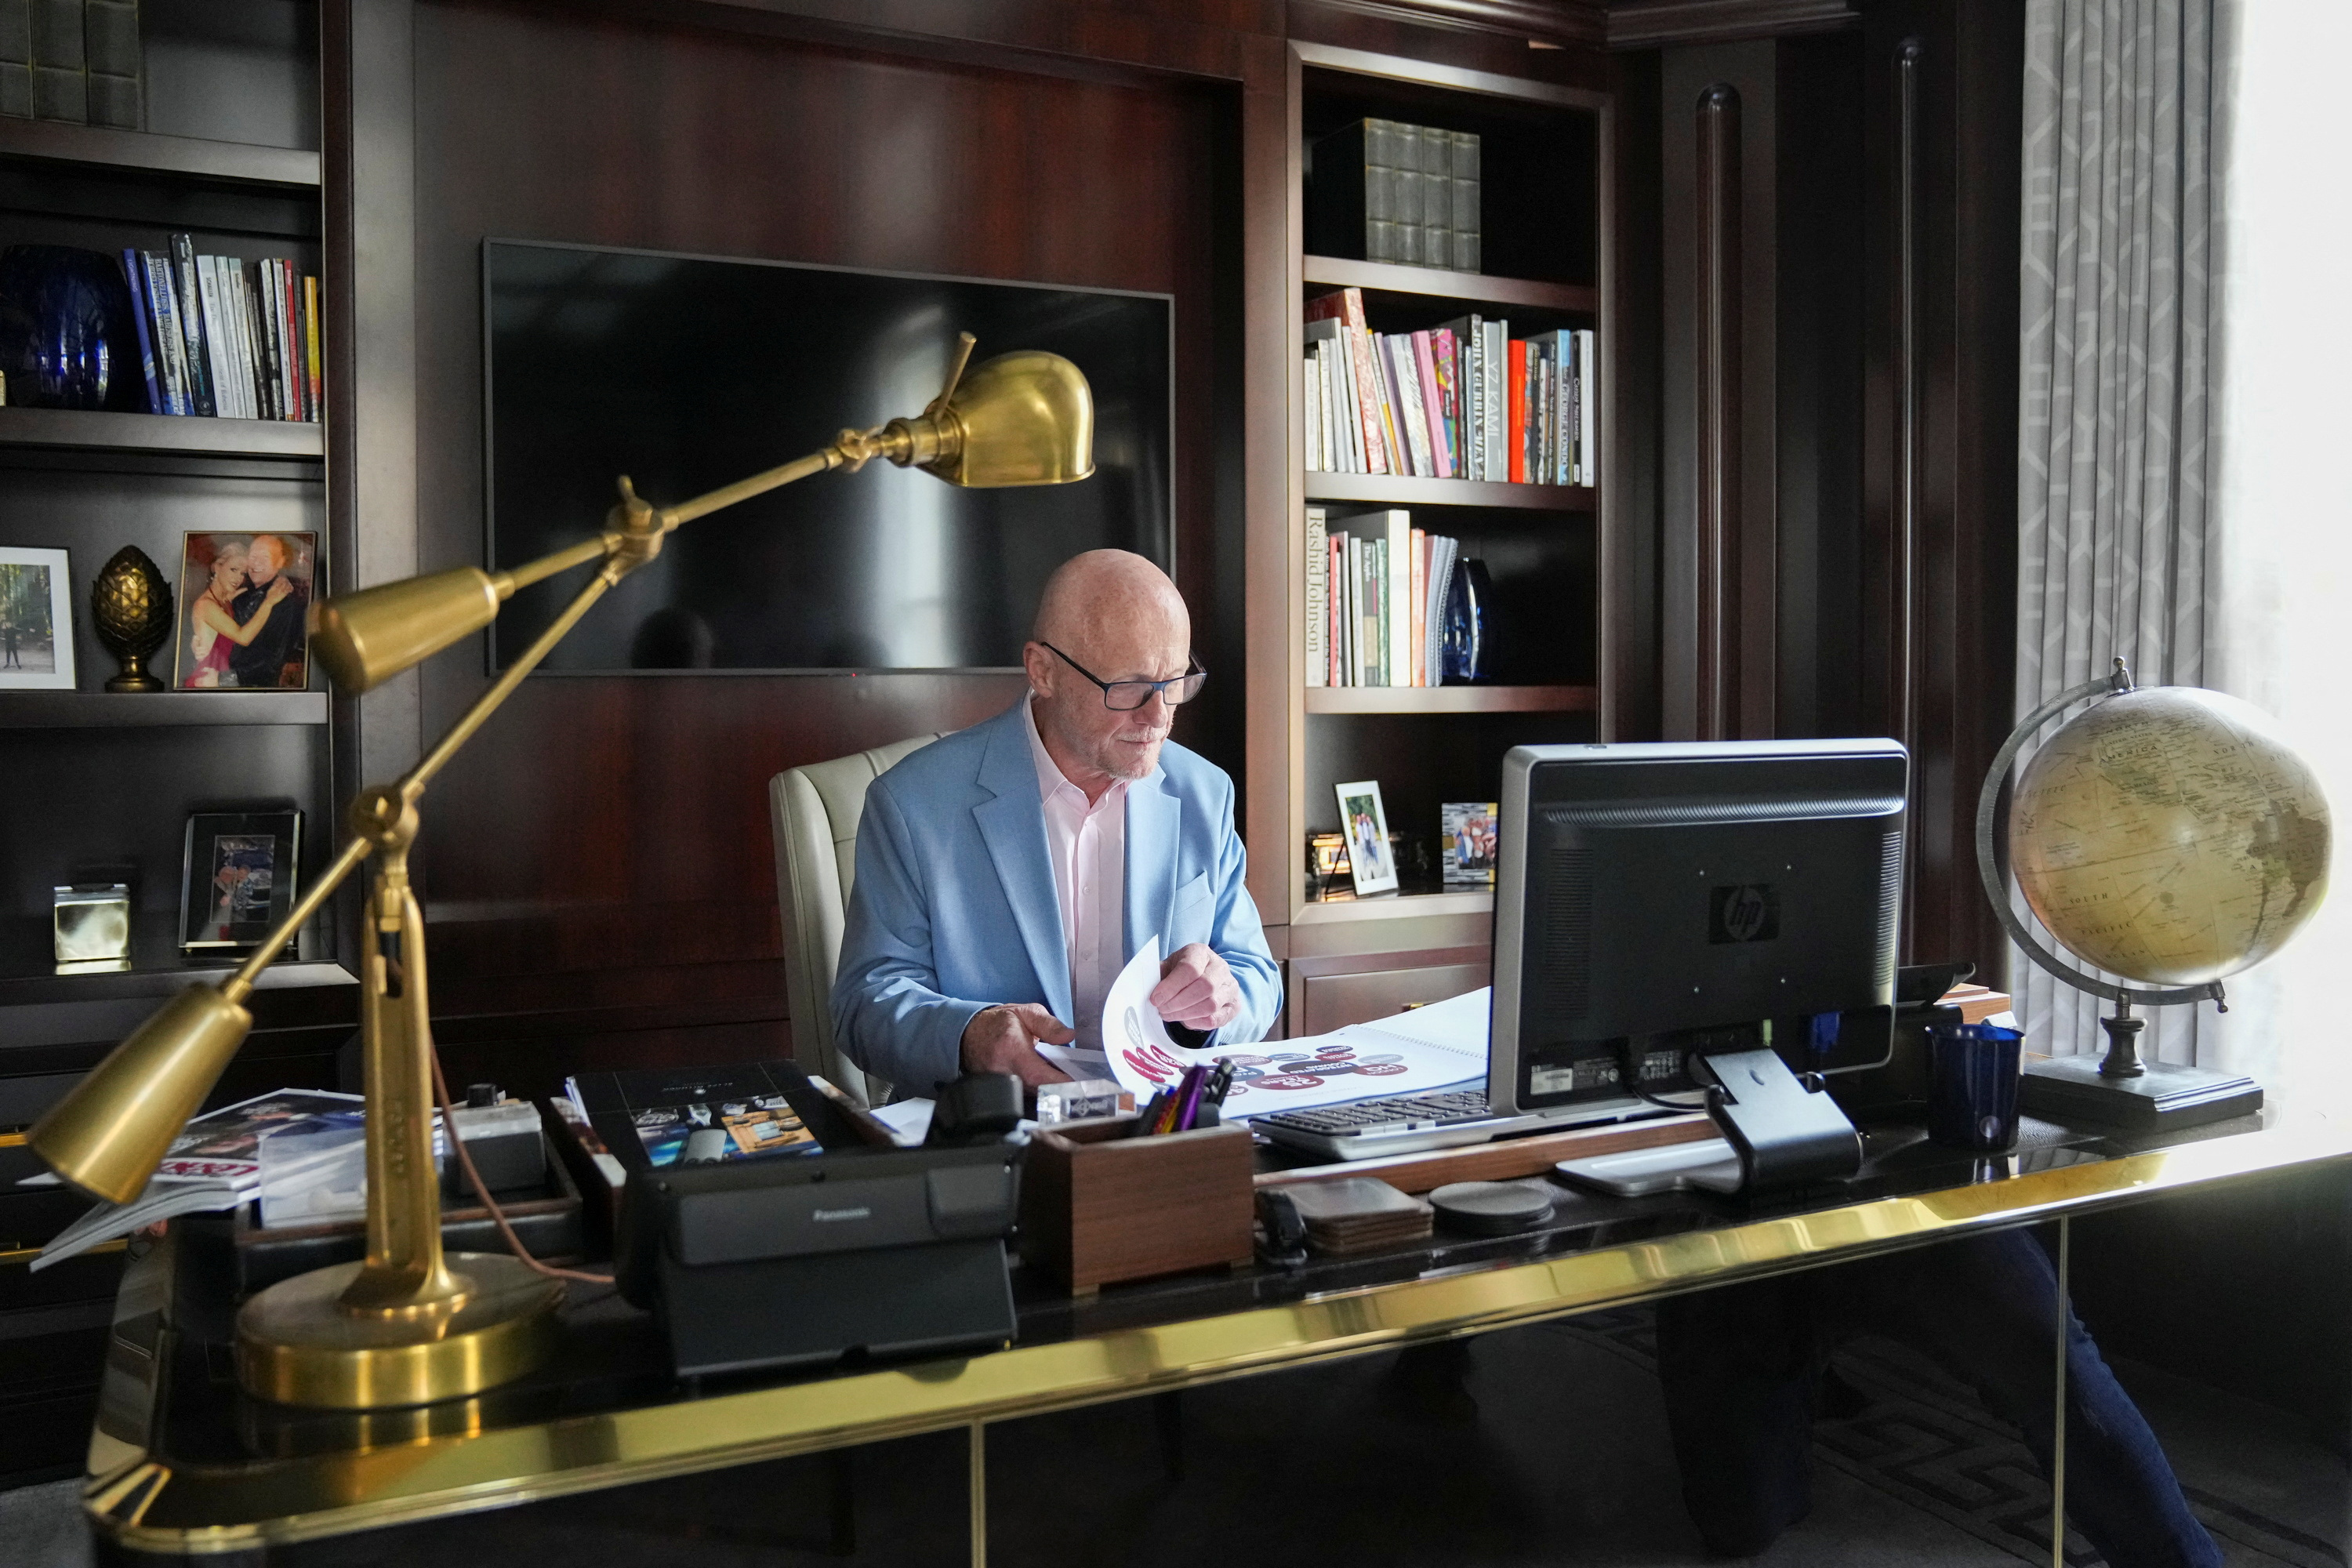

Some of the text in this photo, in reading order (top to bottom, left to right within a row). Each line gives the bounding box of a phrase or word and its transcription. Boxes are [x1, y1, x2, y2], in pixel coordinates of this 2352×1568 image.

[1473, 329, 1482, 368] JOHN
[1474, 372, 1483, 426] CURRIN
[1561, 383, 1570, 427] GEORGE
[1487, 391, 1499, 437] KAMI
[1363, 561, 1371, 582] Apples
[1307, 517, 1324, 652] Rashid Johnson
[2106, 721, 2149, 734] NORTH
[2100, 746, 2158, 763] AMERICA
[2245, 842, 2280, 854] SOUTH
[2070, 893, 2108, 903] SOUTH
[2082, 921, 2131, 934] PACIFIC
[1290, 1064, 1352, 1074] INTEGRATED
[1283, 1078, 1317, 1087] 25
[813, 1207, 871, 1222] Panasonic
